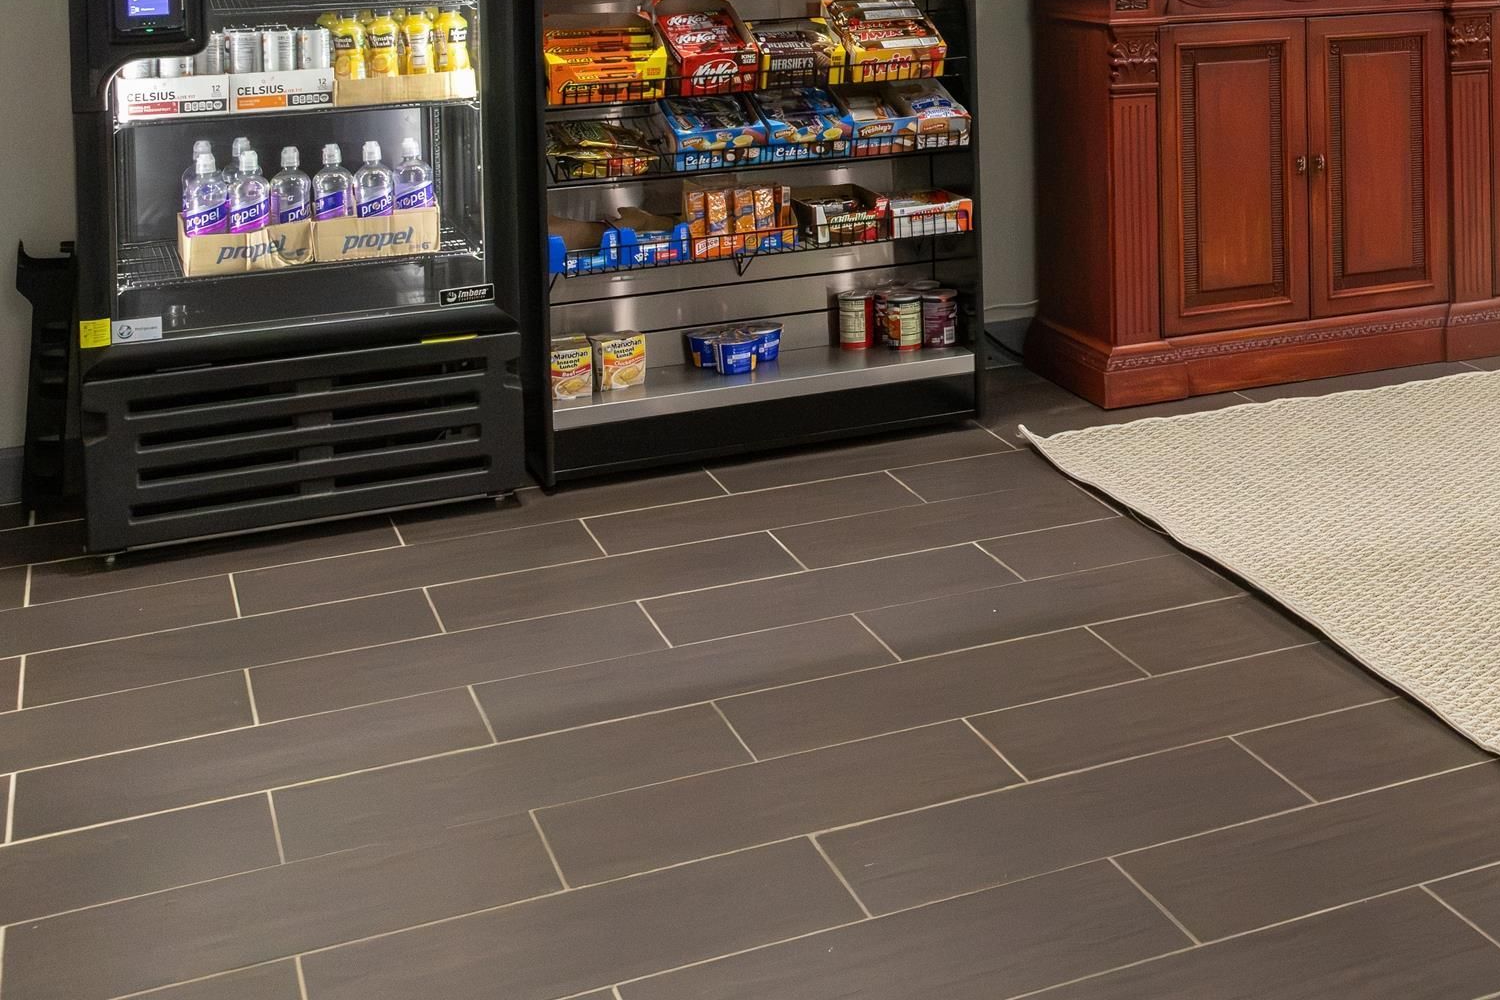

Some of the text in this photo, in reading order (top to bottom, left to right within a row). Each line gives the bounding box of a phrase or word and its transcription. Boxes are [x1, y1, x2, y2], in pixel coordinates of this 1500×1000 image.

[771, 56, 814, 71] HERSHEY'S
[126, 90, 176, 102] CELSIUS
[237, 84, 284, 96] CELSIUS
[361, 194, 392, 217] prope
[231, 205, 260, 224] ropel
[342, 226, 414, 254] propel
[457, 288, 487, 298] imbera
[611, 339, 642, 349] Maruchan
[553, 350, 589, 360] Maruchan
